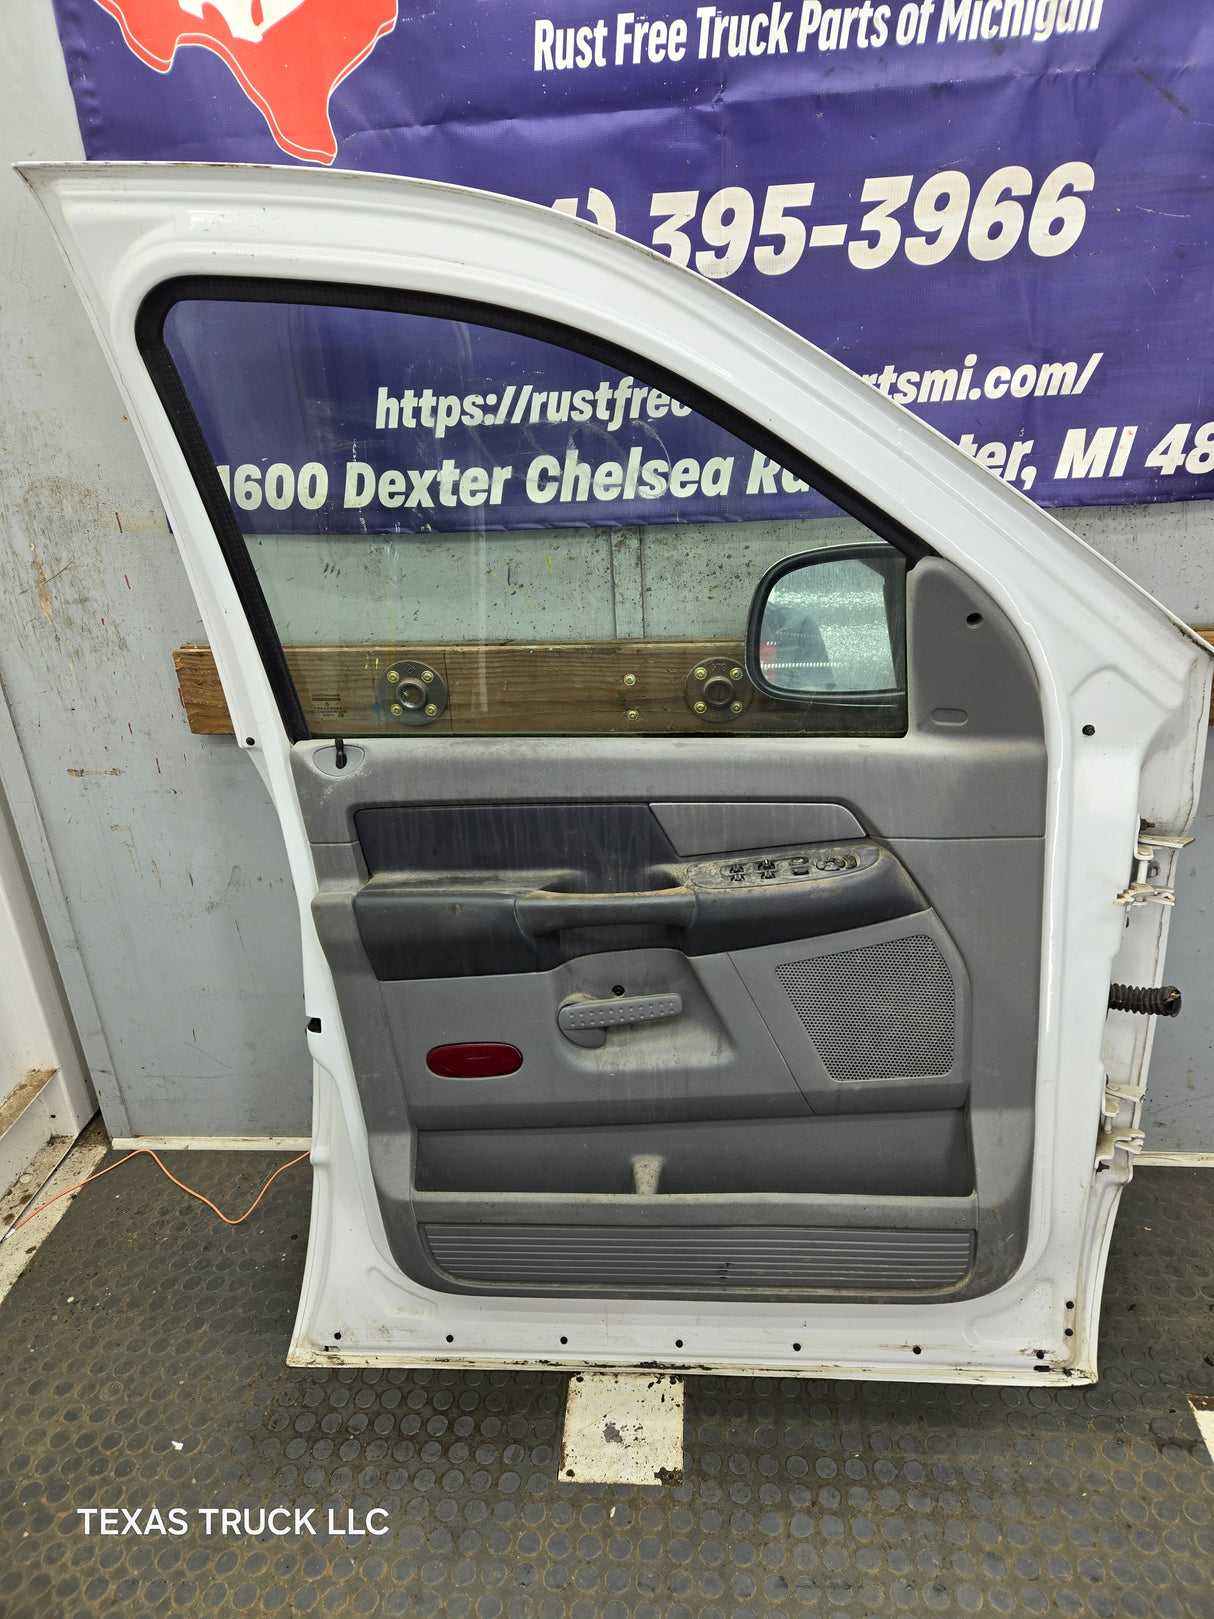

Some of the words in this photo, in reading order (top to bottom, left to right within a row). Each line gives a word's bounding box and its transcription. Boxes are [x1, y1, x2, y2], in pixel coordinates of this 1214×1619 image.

[533, 19, 607, 71] Rust
[615, 10, 687, 64] Free
[698, 4, 789, 58] Truck
[797, 0, 889, 52] Parts
[895, 0, 935, 44] of
[937, 0, 1103, 42] Michigan
[650, 162, 1096, 278] 395-3966
[344, 460, 512, 509] Dexter
[526, 446, 734, 503] Chelsea
[1055, 426, 1138, 478] MI
[1144, 421, 1214, 475] 48
